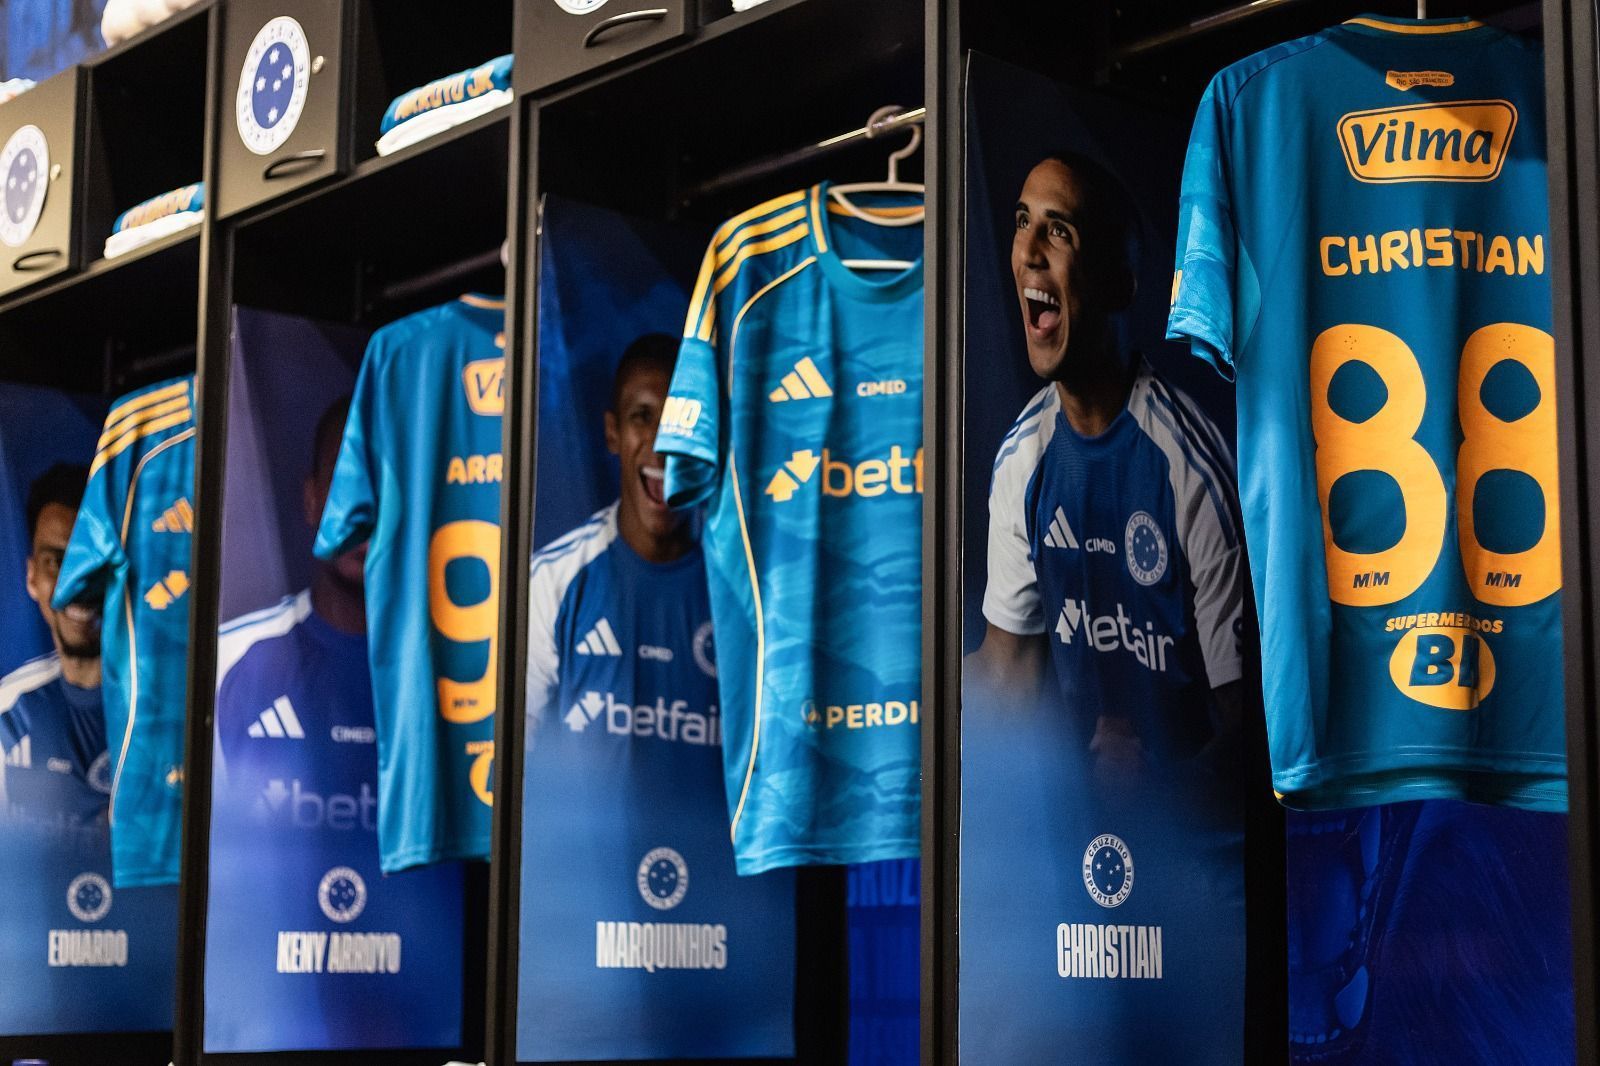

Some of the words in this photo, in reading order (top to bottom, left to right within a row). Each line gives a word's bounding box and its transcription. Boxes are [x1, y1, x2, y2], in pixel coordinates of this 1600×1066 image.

[1351, 118, 1493, 165] Vilma
[1320, 228, 1544, 277] CHRISTIAN
[856, 380, 906, 397] CIMED
[1310, 322, 1563, 607] 88
[1085, 538, 1116, 555] CIMED
[606, 692, 722, 746] betfai
[1088, 837, 1128, 859] CRUZEIRO
[48, 930, 128, 967] EDUARDO
[276, 932, 326, 974] KENY
[327, 933, 401, 974] ARROYO
[596, 921, 727, 973] MARQUINHOS
[1057, 923, 1163, 979] CHRISTIAN
